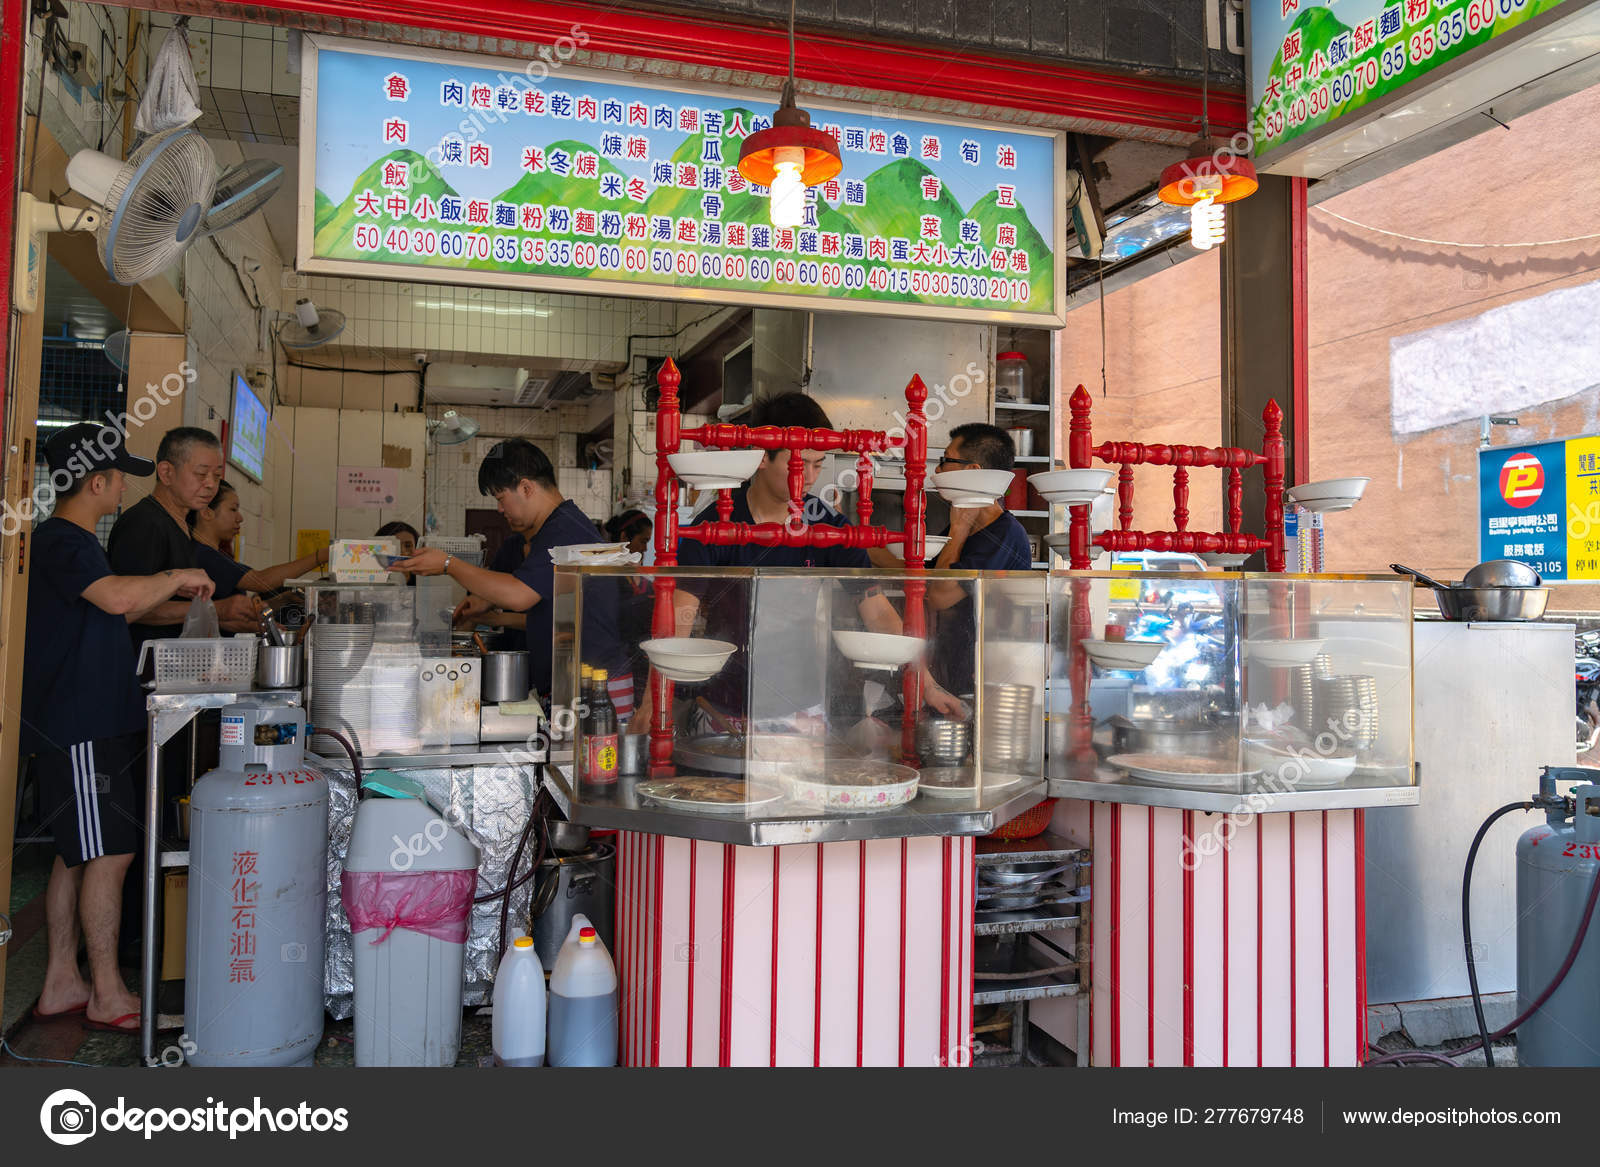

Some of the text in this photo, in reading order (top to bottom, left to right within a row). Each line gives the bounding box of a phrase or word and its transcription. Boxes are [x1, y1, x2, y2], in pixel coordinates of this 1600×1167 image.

[1266, 111, 1283, 138] 50
[1288, 98, 1306, 126] 40
[1309, 87, 1329, 115] 30
[1332, 73, 1352, 103] 60
[1355, 60, 1376, 92] 70
[1383, 45, 1404, 77] 35
[1411, 28, 1434, 61] 35
[1439, 13, 1463, 46] 35
[1469, 0, 1494, 31] 60
[357, 227, 1029, 301] 50 40 30 60 70 35 35 35 60 60 60 50 60 60 60 60 60 60 60 60 40 15 50 30 50 30 20 10
[229, 850, 259, 983] 液化石油氣
